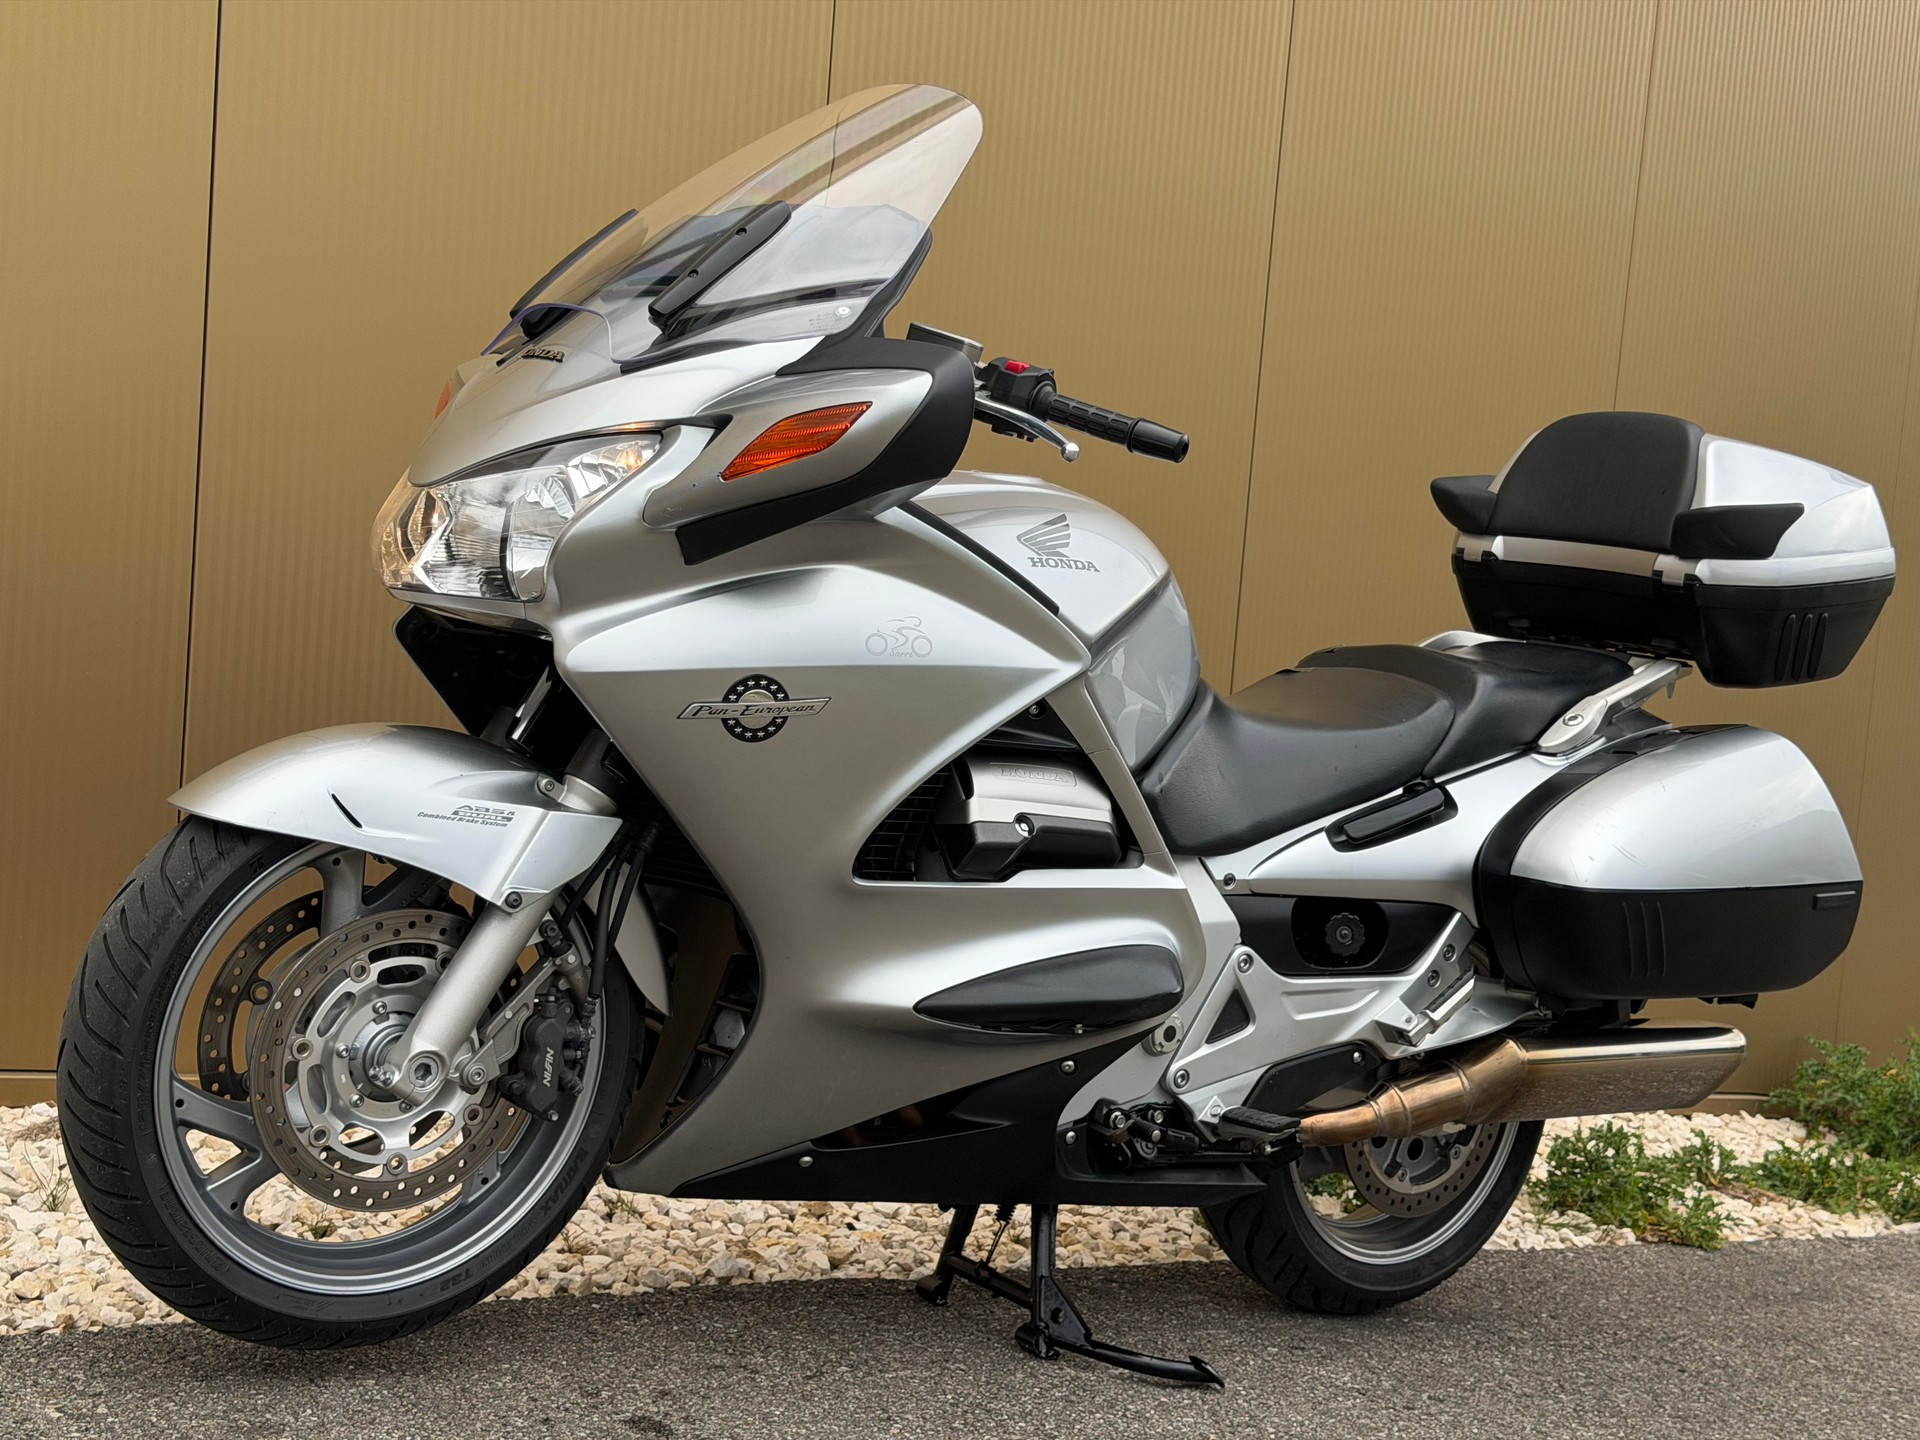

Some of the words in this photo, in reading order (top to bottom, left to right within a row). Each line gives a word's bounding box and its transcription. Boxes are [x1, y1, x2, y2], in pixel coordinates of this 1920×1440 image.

[523, 348, 564, 362] ONDA
[1027, 556, 1101, 573] HONDA
[691, 704, 816, 717] Pan-European
[1000, 768, 1069, 783] HONDA
[417, 811, 457, 822] Combined
[456, 817, 480, 825] Brake
[479, 819, 508, 828] System
[543, 1046, 555, 1088] NISSIN
